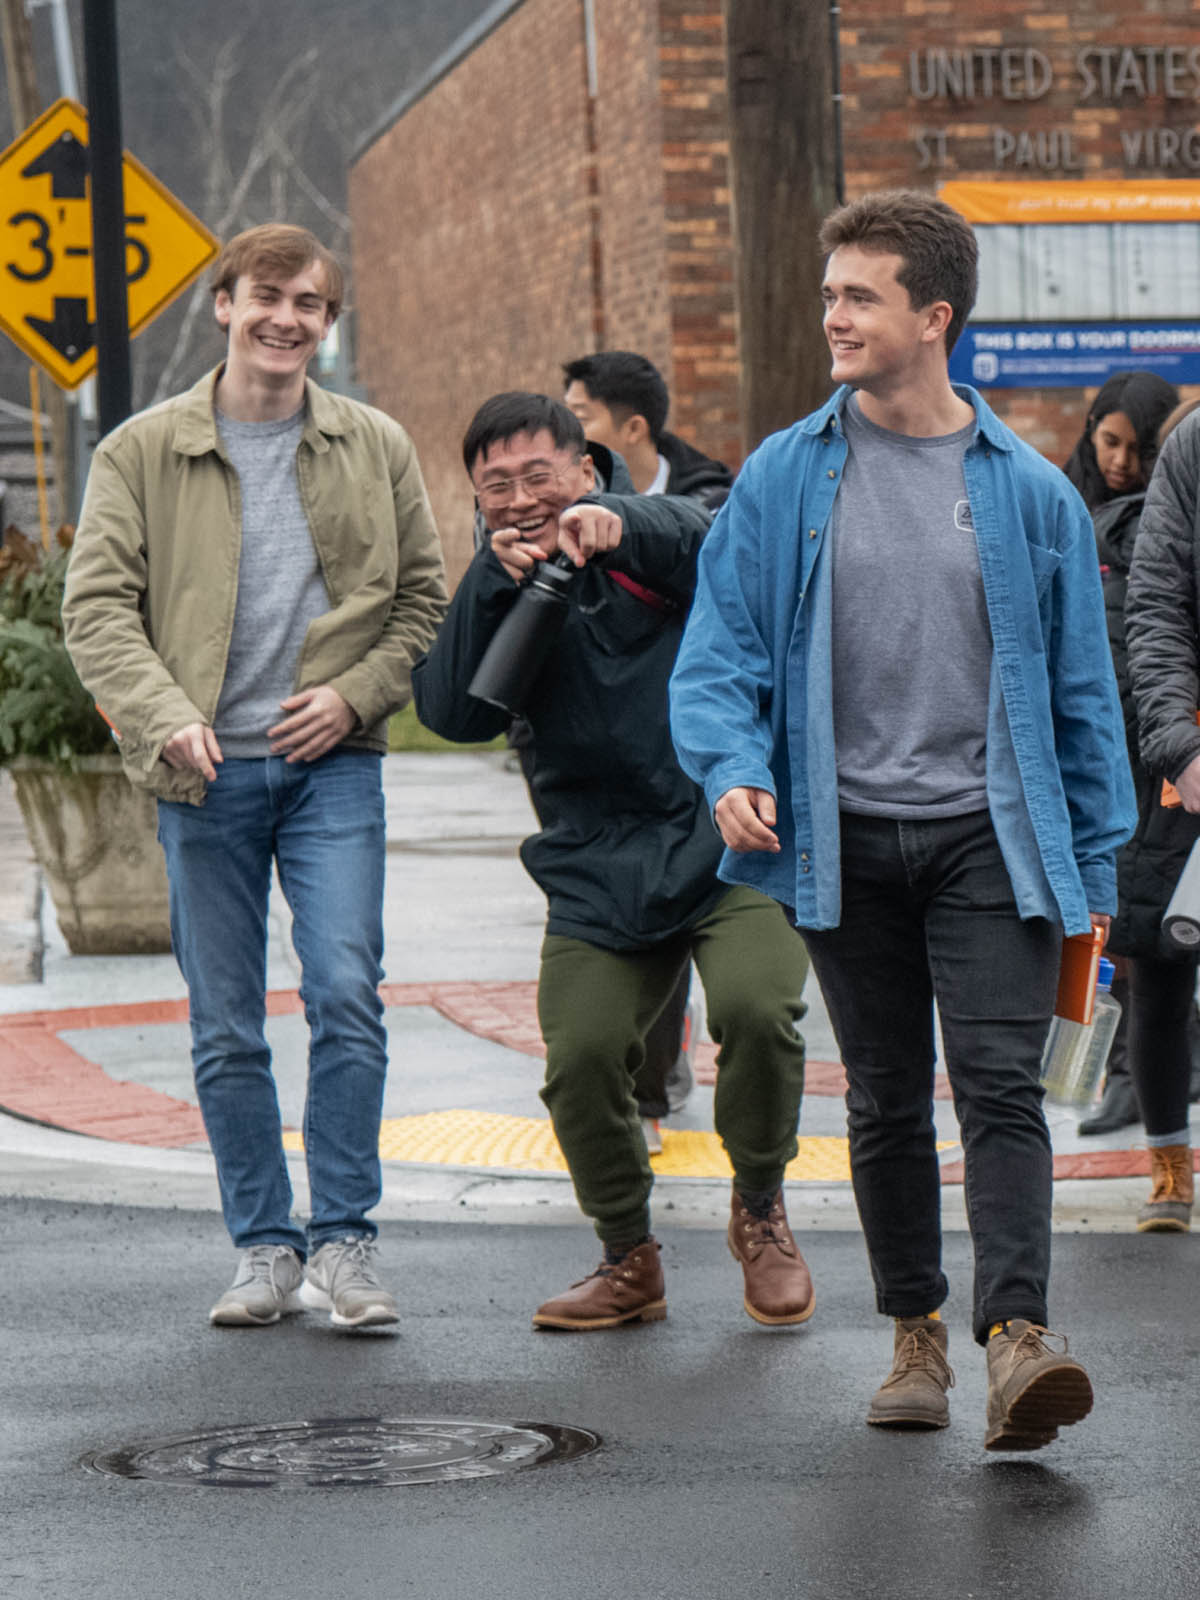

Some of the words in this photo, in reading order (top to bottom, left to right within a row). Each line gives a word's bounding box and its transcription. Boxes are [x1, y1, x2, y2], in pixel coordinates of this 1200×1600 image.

[909, 47, 1053, 100] UNITED
[992, 128, 1081, 171] PAUL
[973, 332, 1015, 350] THIS
[1015, 331, 1053, 350] BOX
[1056, 331, 1075, 349] IS
[1077, 330, 1126, 349] YOUR
